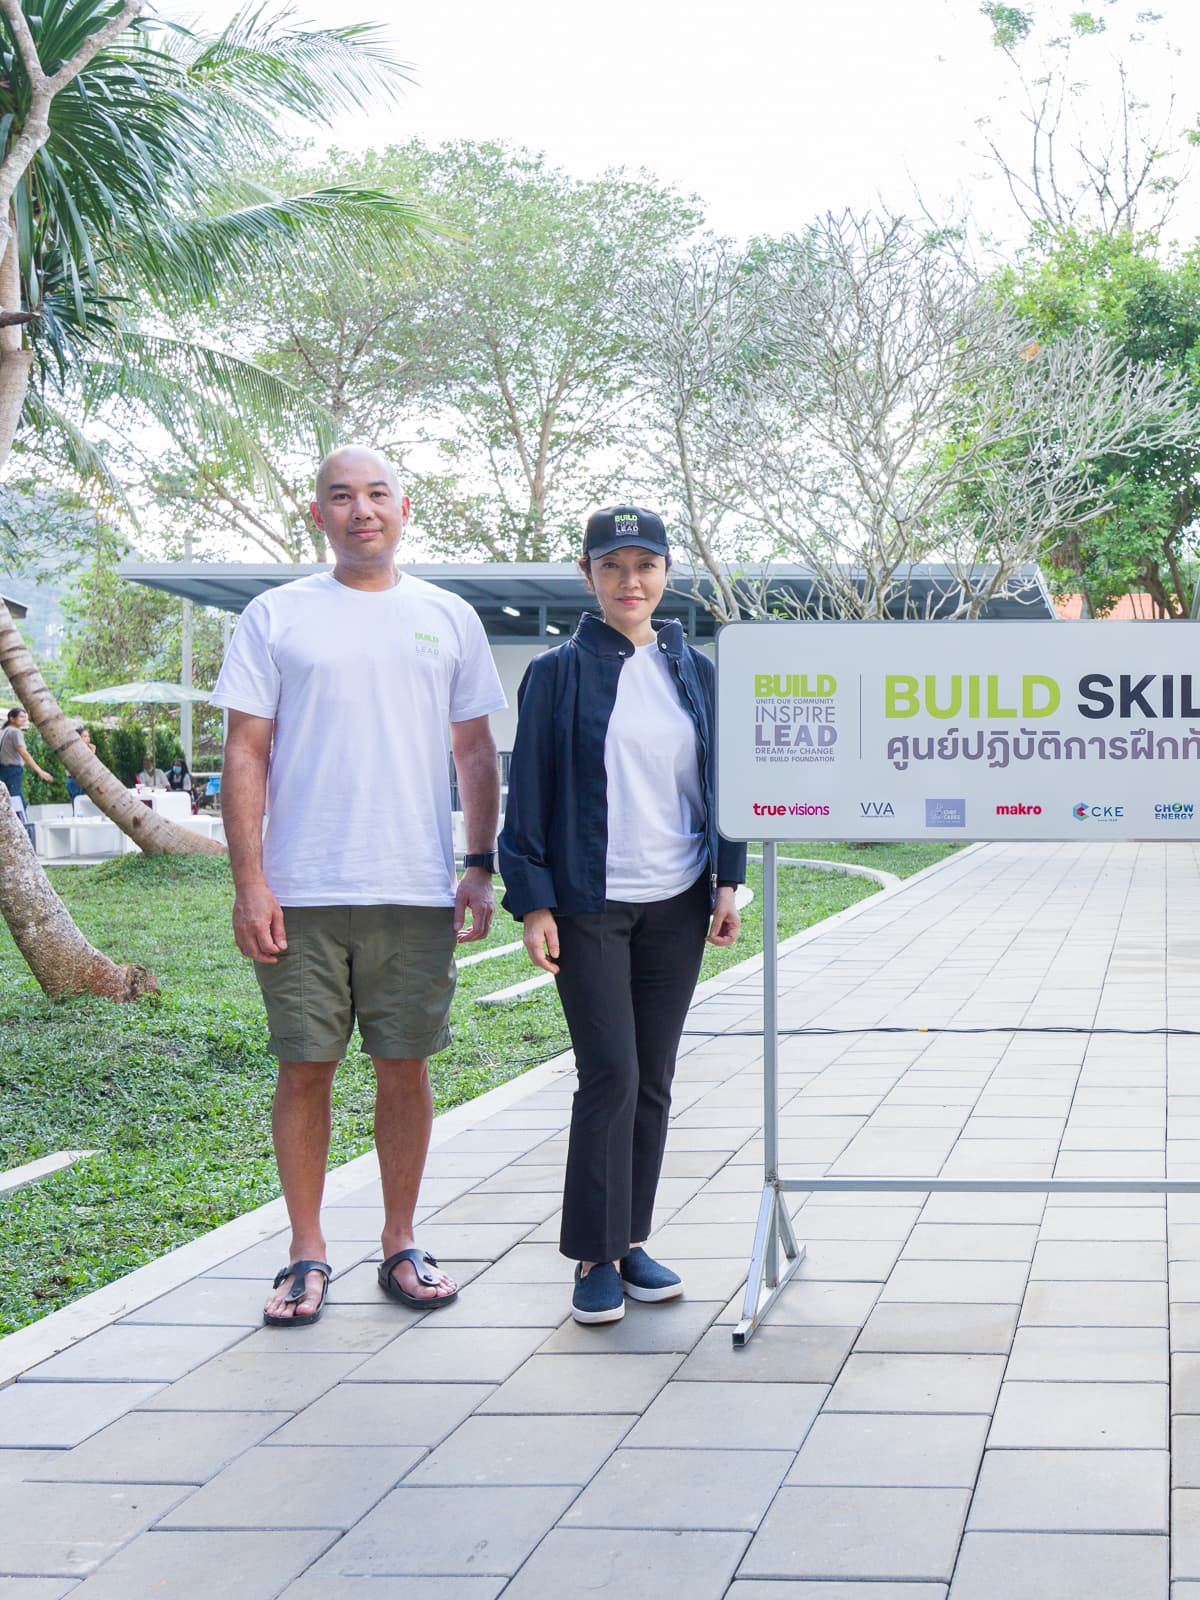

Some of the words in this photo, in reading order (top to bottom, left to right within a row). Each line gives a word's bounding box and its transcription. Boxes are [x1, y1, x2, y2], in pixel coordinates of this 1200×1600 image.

[615, 514, 638, 522] BUILD
[754, 674, 837, 698] BUILD
[885, 674, 1061, 719] BUILD
[755, 705, 836, 723] INSPIRE
[755, 724, 838, 747] LEAD
[755, 747, 784, 755] DREAM
[786, 747, 797, 755] for
[800, 747, 834, 755] CHANGE
[753, 803, 787, 816] true
[788, 803, 830, 816] visions
[860, 802, 895, 815] VVA
[996, 803, 1042, 815] makro
[1091, 806, 1124, 817] CKE
[1154, 803, 1194, 813] CHOW
